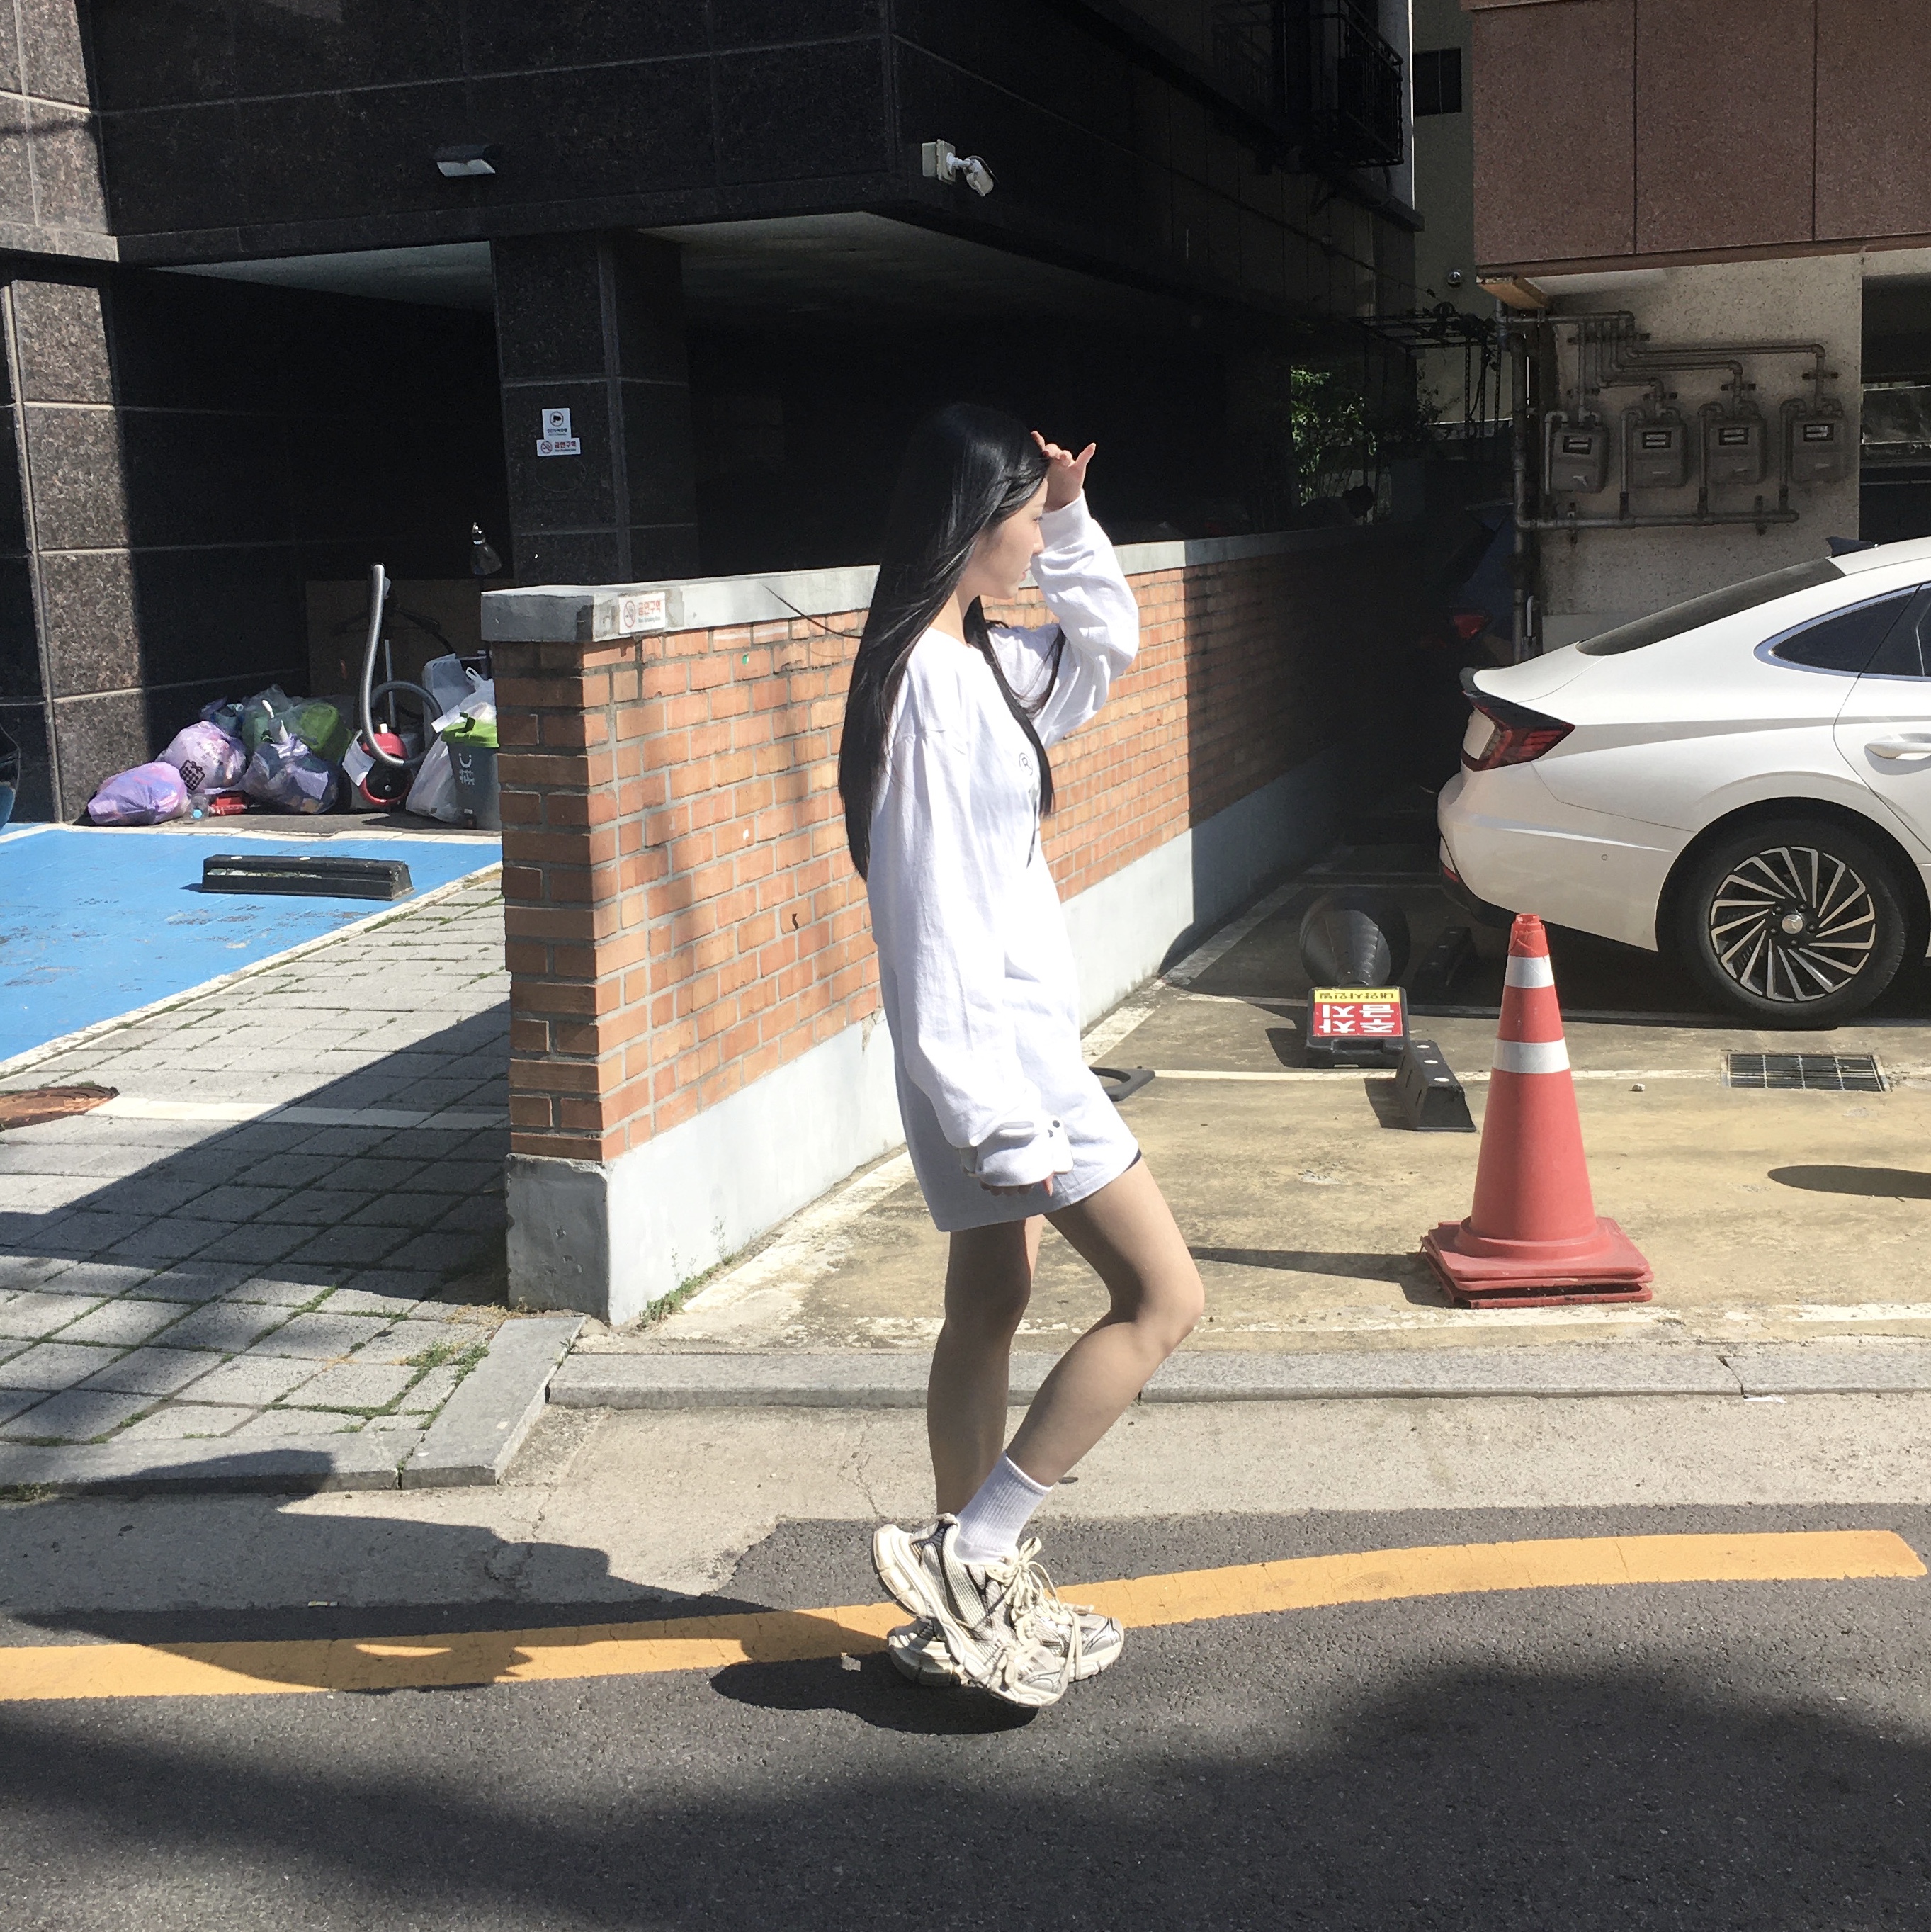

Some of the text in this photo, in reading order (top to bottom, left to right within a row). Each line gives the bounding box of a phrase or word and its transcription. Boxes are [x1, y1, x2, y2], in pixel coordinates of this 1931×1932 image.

[638, 600, 661, 616] 금연구역
[1322, 1004, 1395, 1018] 금지
[1318, 1019, 1395, 1034] 주차
